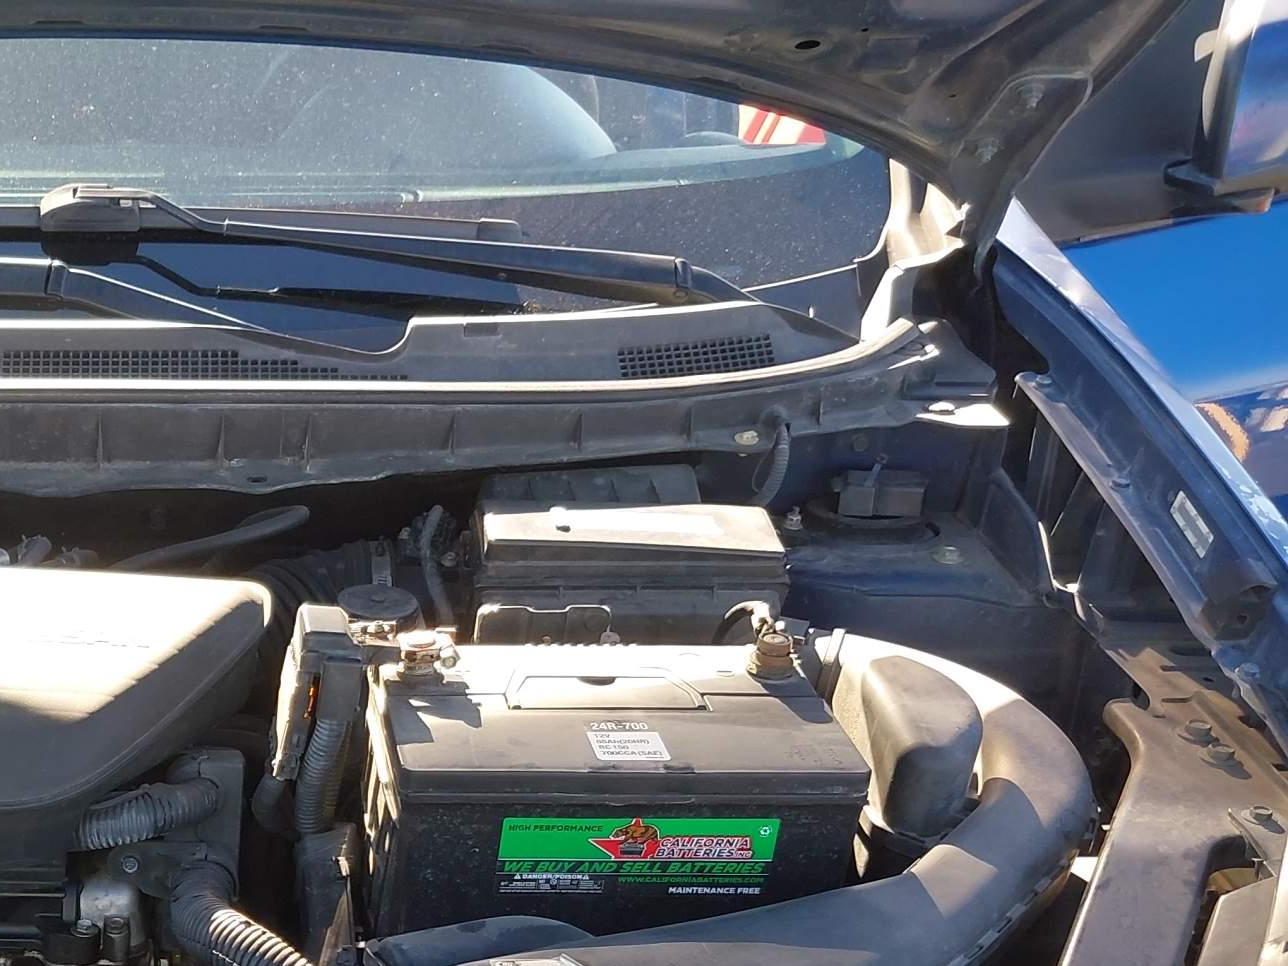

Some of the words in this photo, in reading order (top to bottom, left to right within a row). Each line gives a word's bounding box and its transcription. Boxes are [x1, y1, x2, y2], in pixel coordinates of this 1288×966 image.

[533, 824, 604, 832] PERFORMANCE
[660, 837, 751, 849] CALIFORNIA
[655, 848, 735, 858] BATTERIES
[503, 861, 532, 873] WE
[535, 861, 574, 873] BUY
[575, 861, 618, 873] AND
[618, 862, 665, 873] SELL
[666, 862, 765, 874] BATTERIES
[617, 876, 764, 884] WWW.CALIFORNIABATTERIES.COM
[668, 886, 736, 894] MAINTENANCE
[736, 887, 761, 895] FREE
